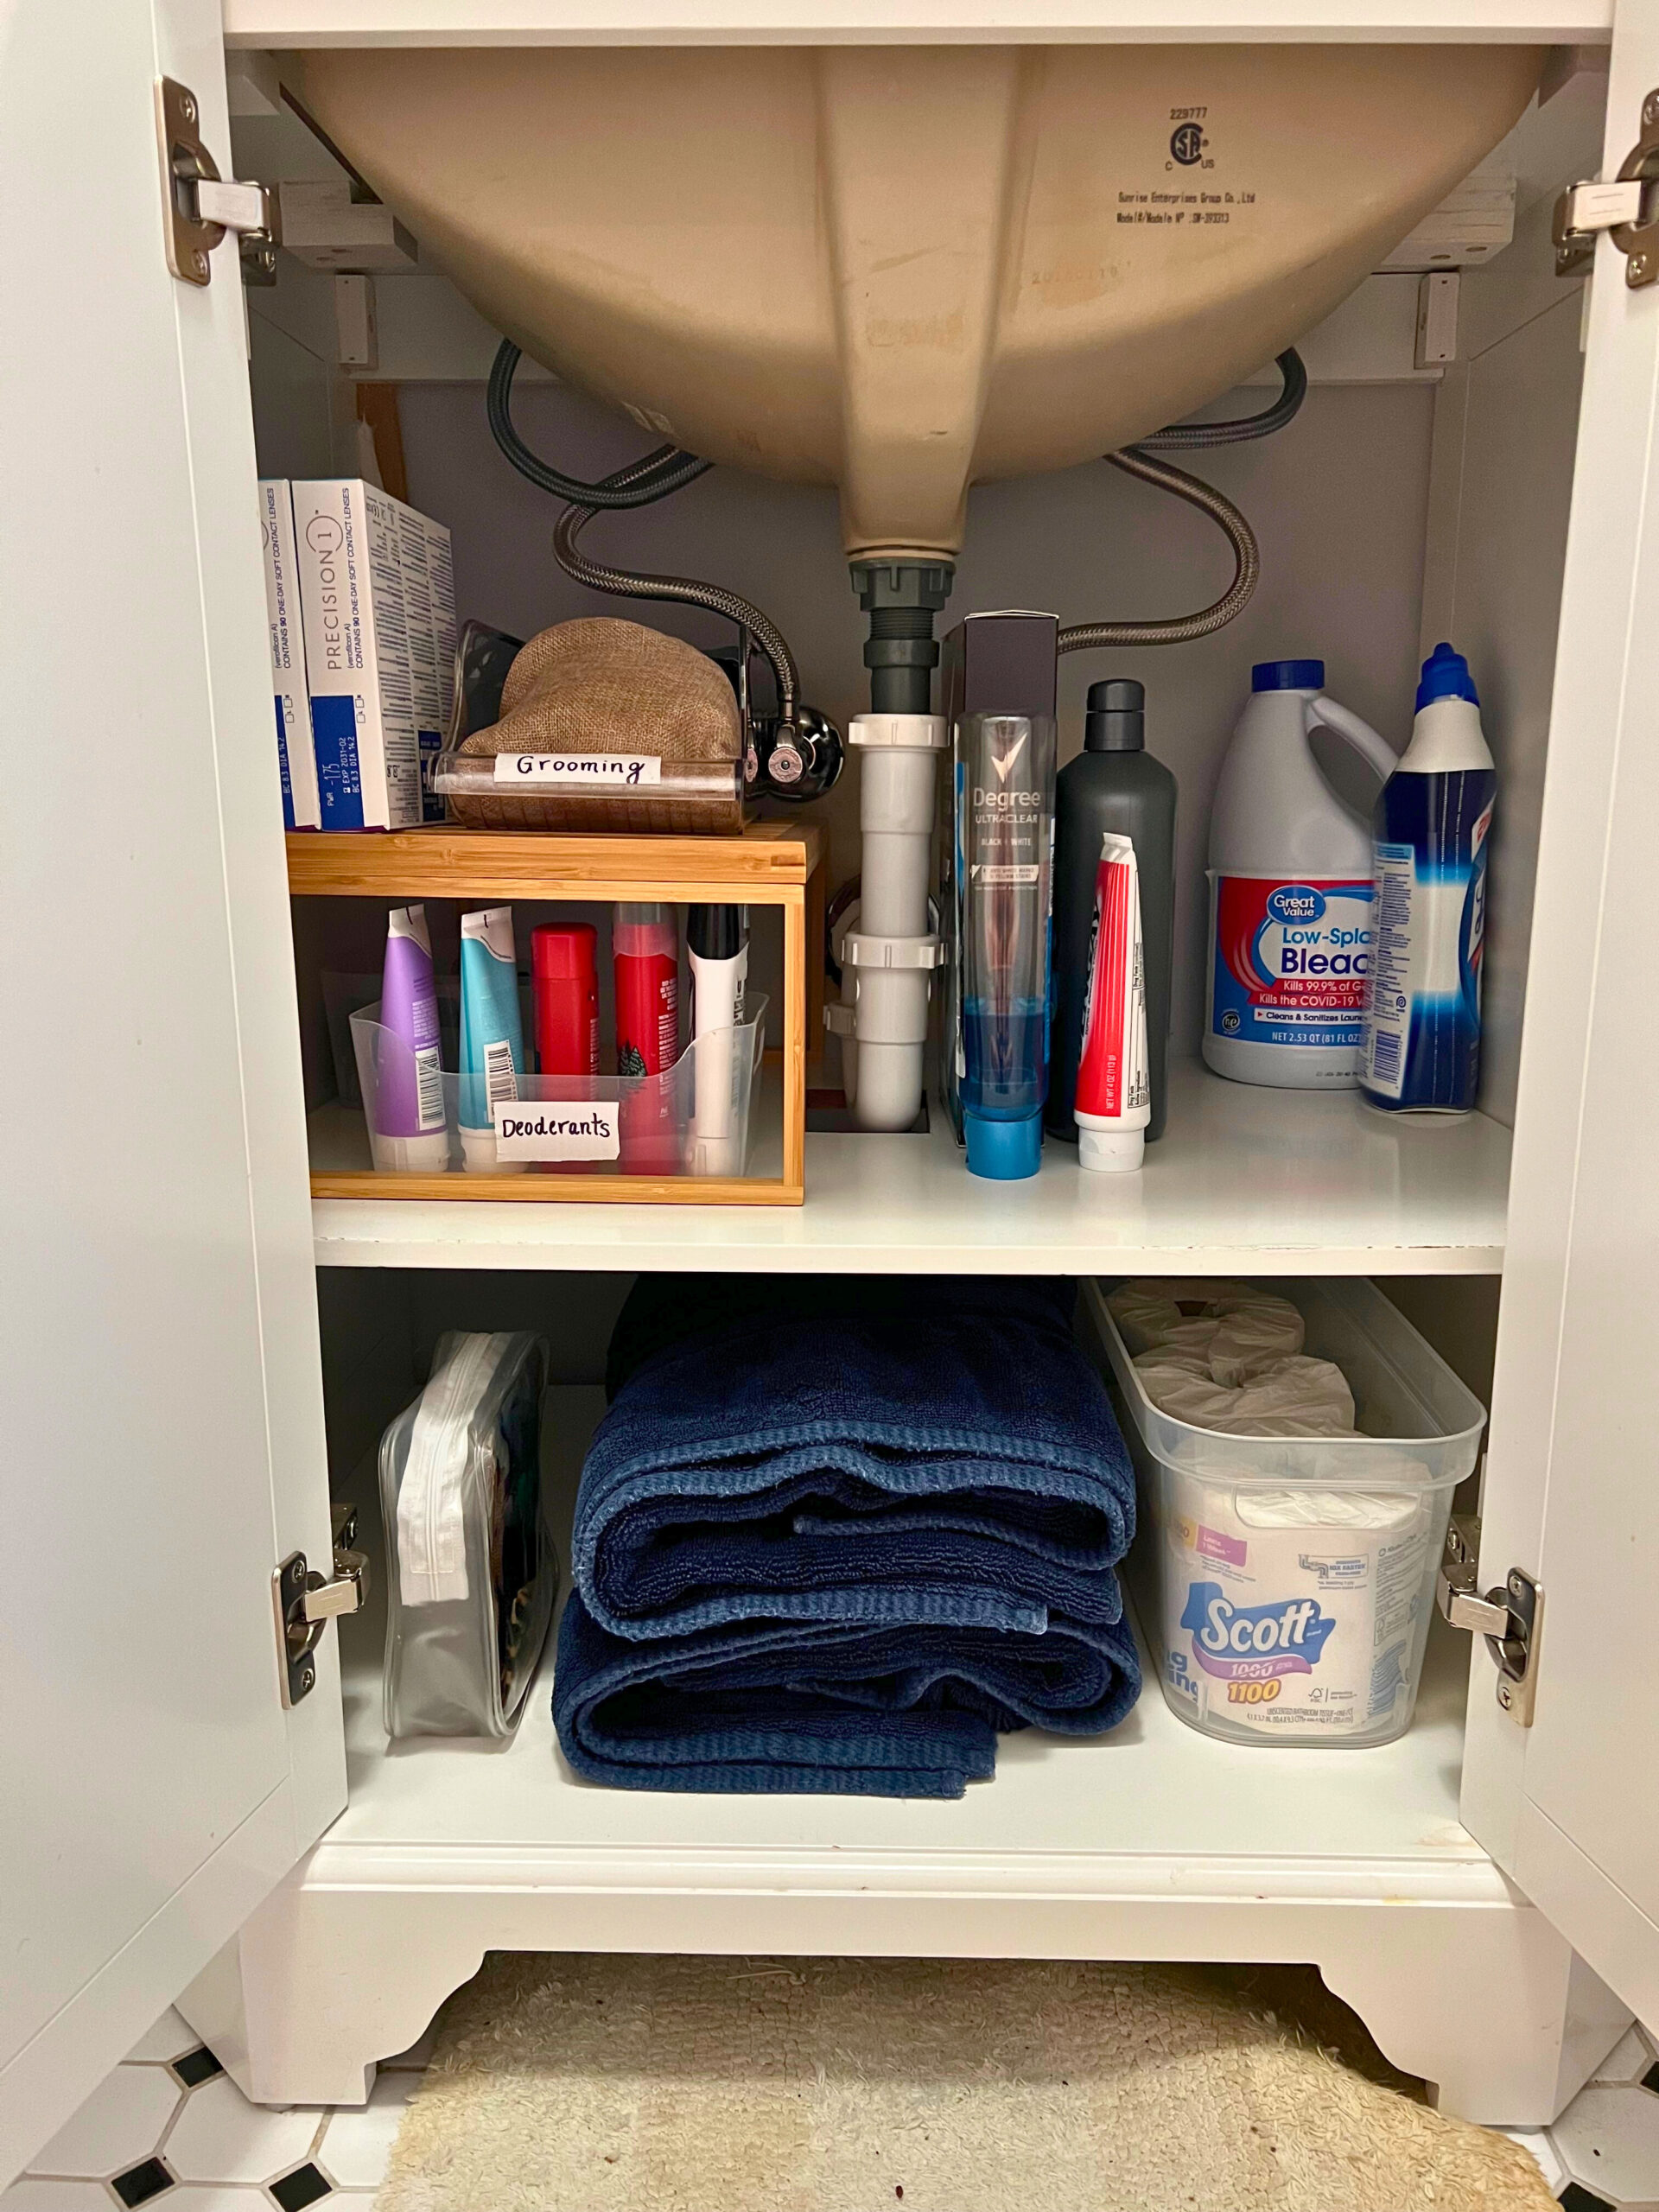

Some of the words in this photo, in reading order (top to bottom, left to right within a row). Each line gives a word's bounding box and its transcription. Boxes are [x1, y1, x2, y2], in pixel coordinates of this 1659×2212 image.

[1169, 107, 1207, 119] 229777
[1201, 159, 1215, 168] US
[1118, 191, 1147, 203] Sunrise
[1151, 191, 1197, 204] Enterprises
[1200, 192, 1222, 204] Group
[267, 487, 276, 519] LENSES
[341, 487, 350, 519] LENSES
[270, 521, 280, 558] CONTACT
[344, 521, 354, 558] CONTACT
[274, 560, 283, 581] SOFT
[347, 560, 356, 581] SOFT
[276, 582, 286, 616] ONE-DAY
[350, 582, 359, 616] ONE-DAY
[319, 550, 342, 670] PRECISION
[279, 617, 287, 627] 90
[353, 617, 359, 627] 90
[281, 628, 291, 669] CONTAINS
[353, 628, 364, 669] CONTAINS
[339, 737, 348, 767] 2031-02
[349, 753, 358, 766] DIA
[341, 769, 351, 784] EXP
[517, 755, 645, 785] Grooming
[283, 784, 291, 793] BC
[352, 783, 360, 793] BC
[974, 787, 1040, 812] Degree
[976, 814, 1038, 823] ULTRACLEAR
[981, 837, 1001, 846] BLACK
[1011, 837, 1032, 846] WHITE
[1274, 894, 1315, 908] Great
[1283, 907, 1314, 917] Value
[1281, 947, 1368, 975] Bleac
[1283, 981, 1303, 991] Kills
[1306, 981, 1337, 992] 99.9%
[1339, 981, 1350, 991] of
[1259, 994, 1277, 1005] Kills
[1280, 995, 1297, 1006] the
[1300, 995, 1354, 1007] COVID-19
[1266, 1011, 1294, 1020] Cleans
[1303, 1013, 1338, 1021] Sanitizes
[1272, 1032, 1287, 1041] NET
[1288, 1033, 1307, 1042] 2.53
[1309, 1033, 1320, 1043] QT
[1321, 1033, 1335, 1044] (81
[1337, 1033, 1346, 1043] FL
[1106, 1062, 1116, 1074] (113
[1106, 1074, 1115, 1083] OZ
[1106, 1088, 1115, 1097] WT
[1105, 1098, 1114, 1109] NET
[502, 1112, 610, 1138] Deoderants
[1201, 1599, 1315, 1652] Scott
[1231, 1662, 1274, 1677] 1000
[1228, 1678, 1281, 1705] 1100
